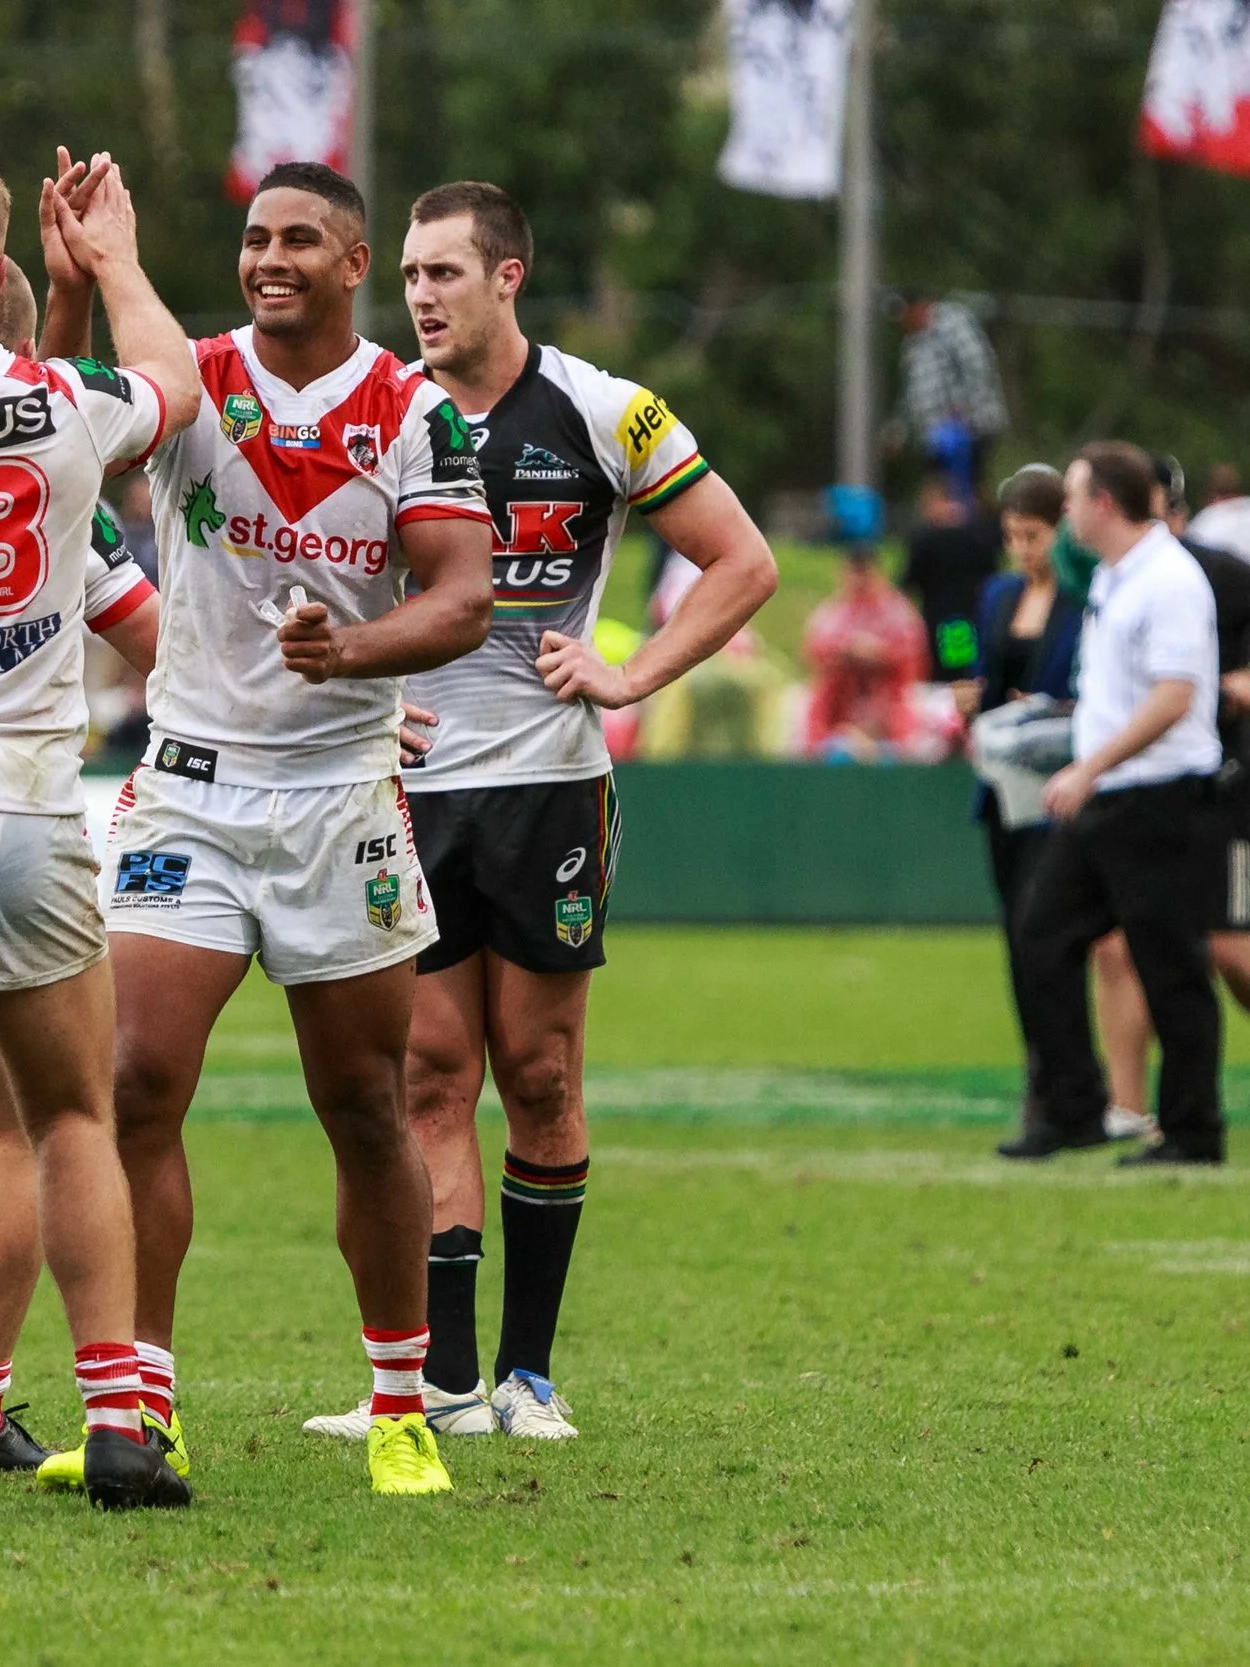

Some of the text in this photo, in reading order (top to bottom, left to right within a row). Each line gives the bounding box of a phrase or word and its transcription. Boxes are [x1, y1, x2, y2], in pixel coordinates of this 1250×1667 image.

[232, 398, 258, 412] NRL
[269, 424, 321, 440] BINGO
[187, 757, 211, 771] ISC
[355, 833, 396, 864] ISC
[373, 882, 396, 896] NRL
[562, 902, 587, 914] NRL
